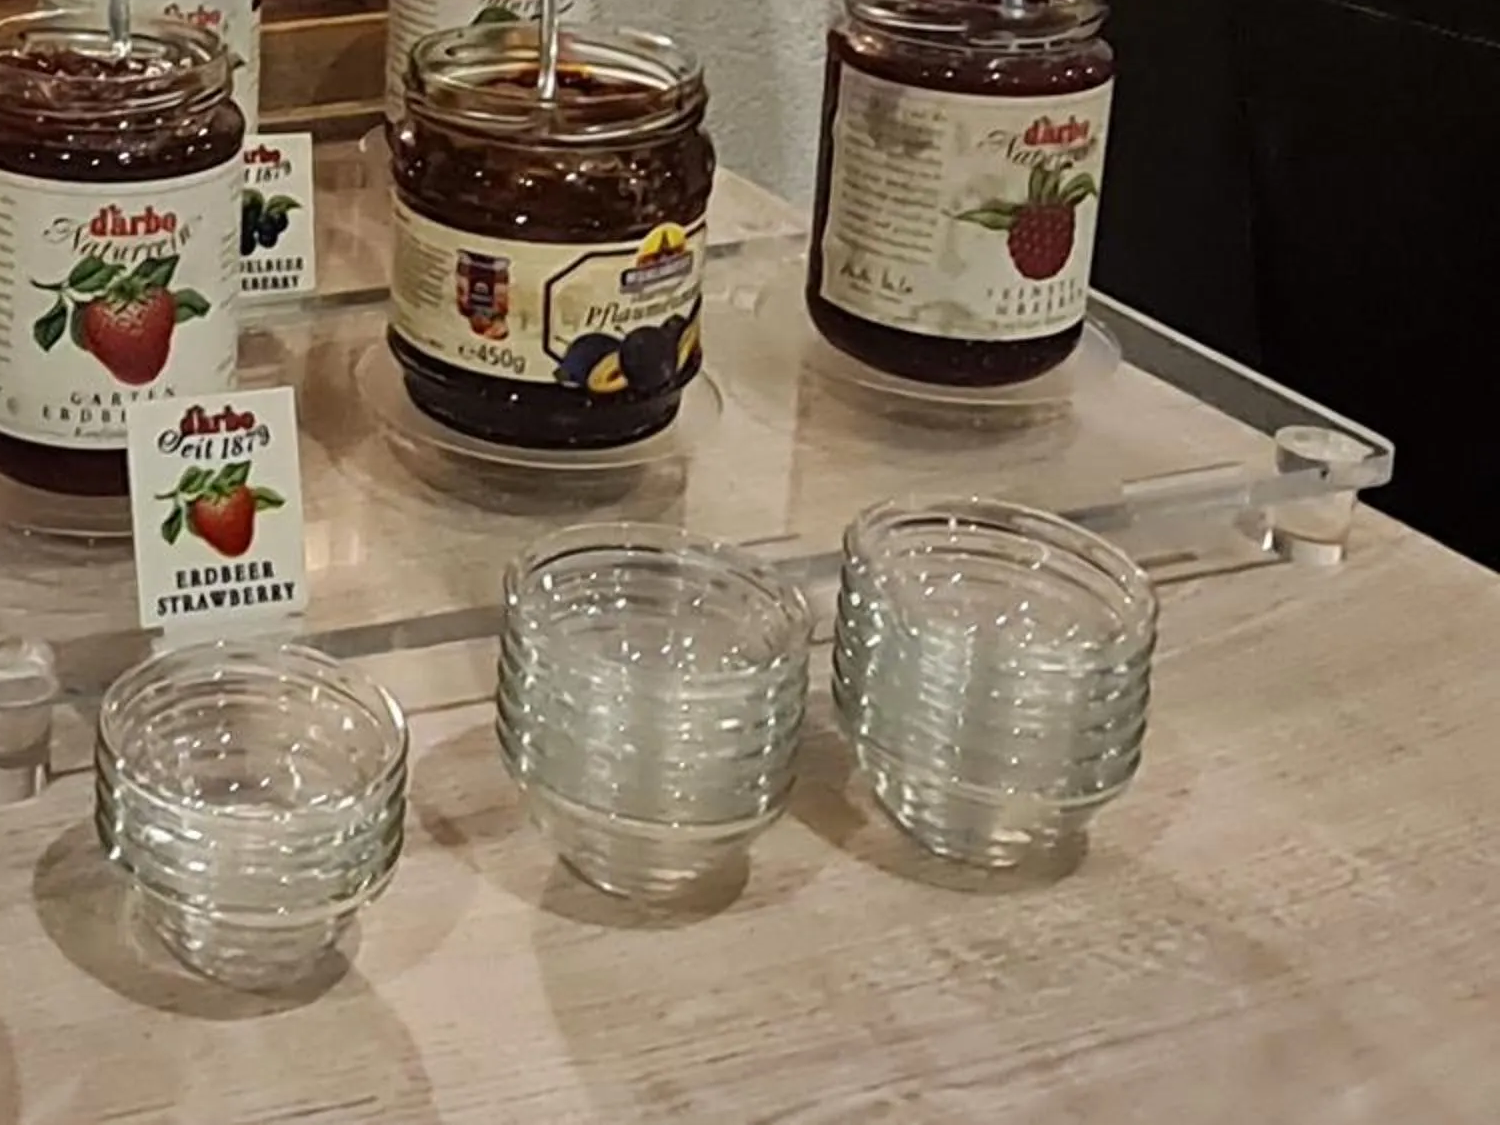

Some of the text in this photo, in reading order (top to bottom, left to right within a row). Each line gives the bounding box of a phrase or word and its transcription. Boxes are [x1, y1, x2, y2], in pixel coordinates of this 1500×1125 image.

[243, 143, 281, 164] arbo
[156, 424, 271, 460] Seit 1879
[175, 560, 274, 590] ERDBEER
[156, 581, 296, 617] STRAWBERRY
